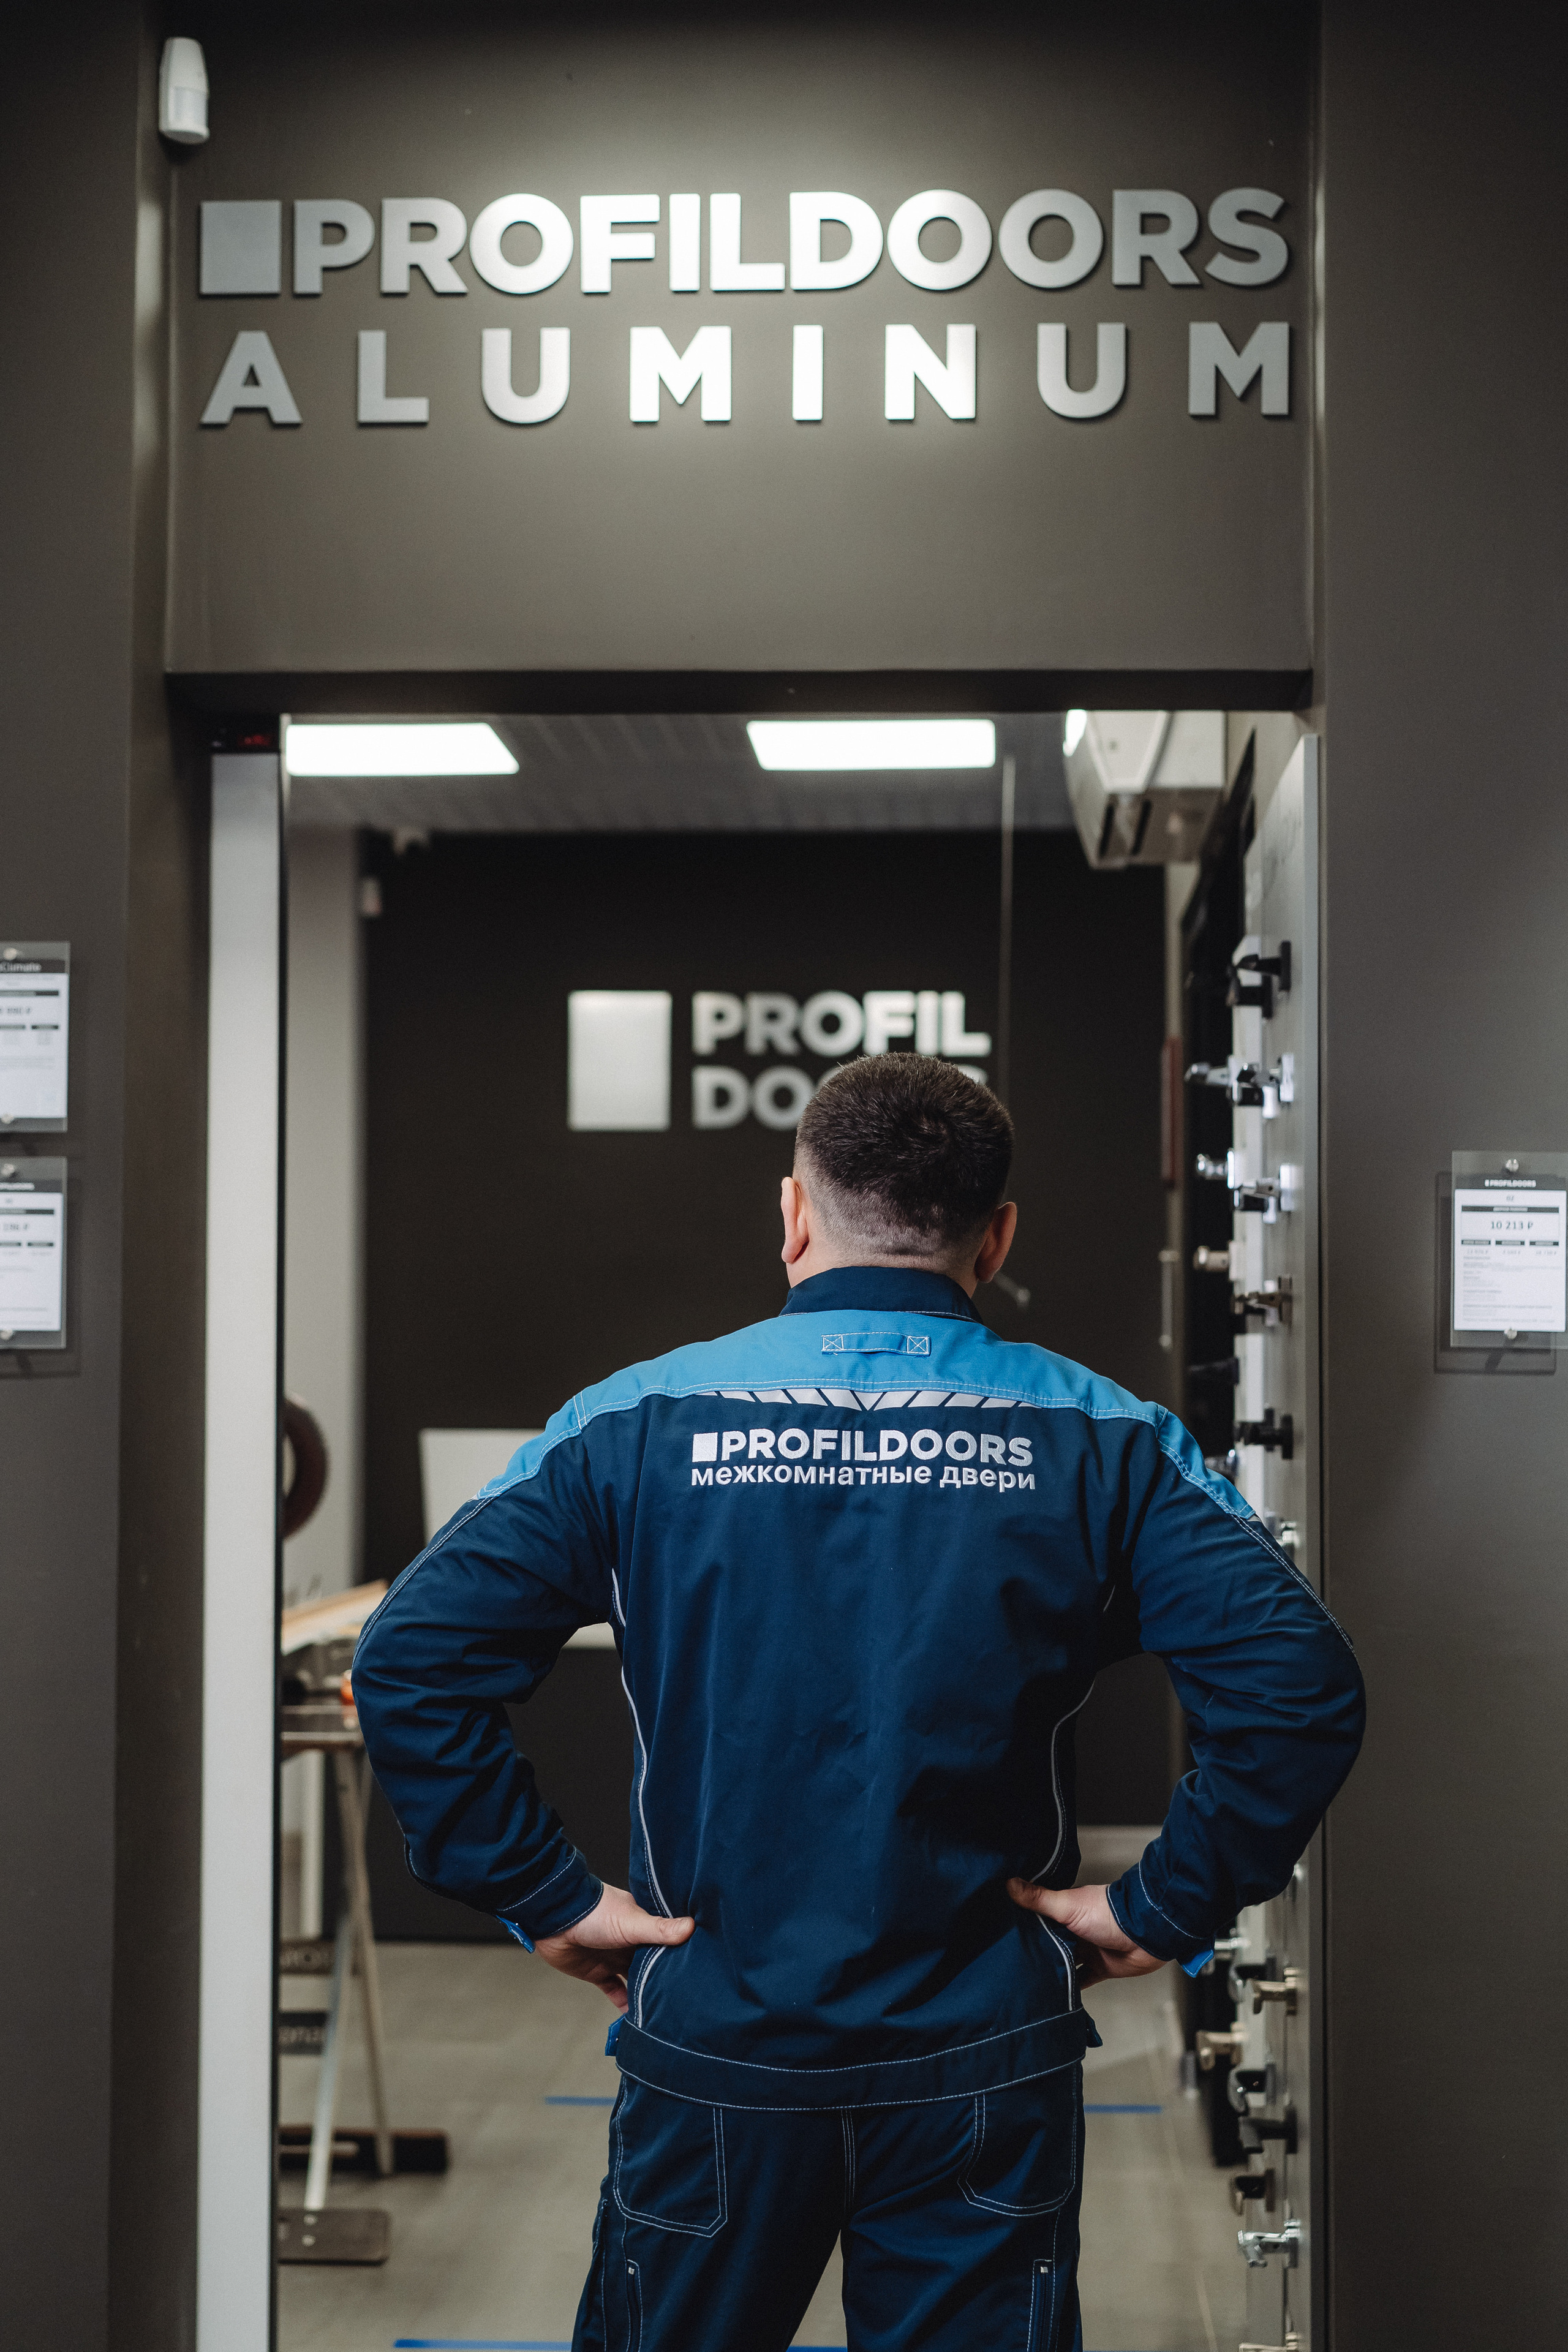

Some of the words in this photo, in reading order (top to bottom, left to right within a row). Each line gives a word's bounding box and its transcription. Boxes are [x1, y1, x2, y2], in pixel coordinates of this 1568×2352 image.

[293, 187, 1289, 295] PROFILDOORS
[200, 320, 1290, 424] ALUMINUM
[691, 990, 992, 1057] PROFIL
[1491, 1221, 1502, 1230] 10
[1505, 1221, 1524, 1230] 213
[721, 1428, 1034, 1467] PROFILDOORS
[691, 1464, 932, 1486] межкомнатные
[939, 1466, 1036, 1493] двери
